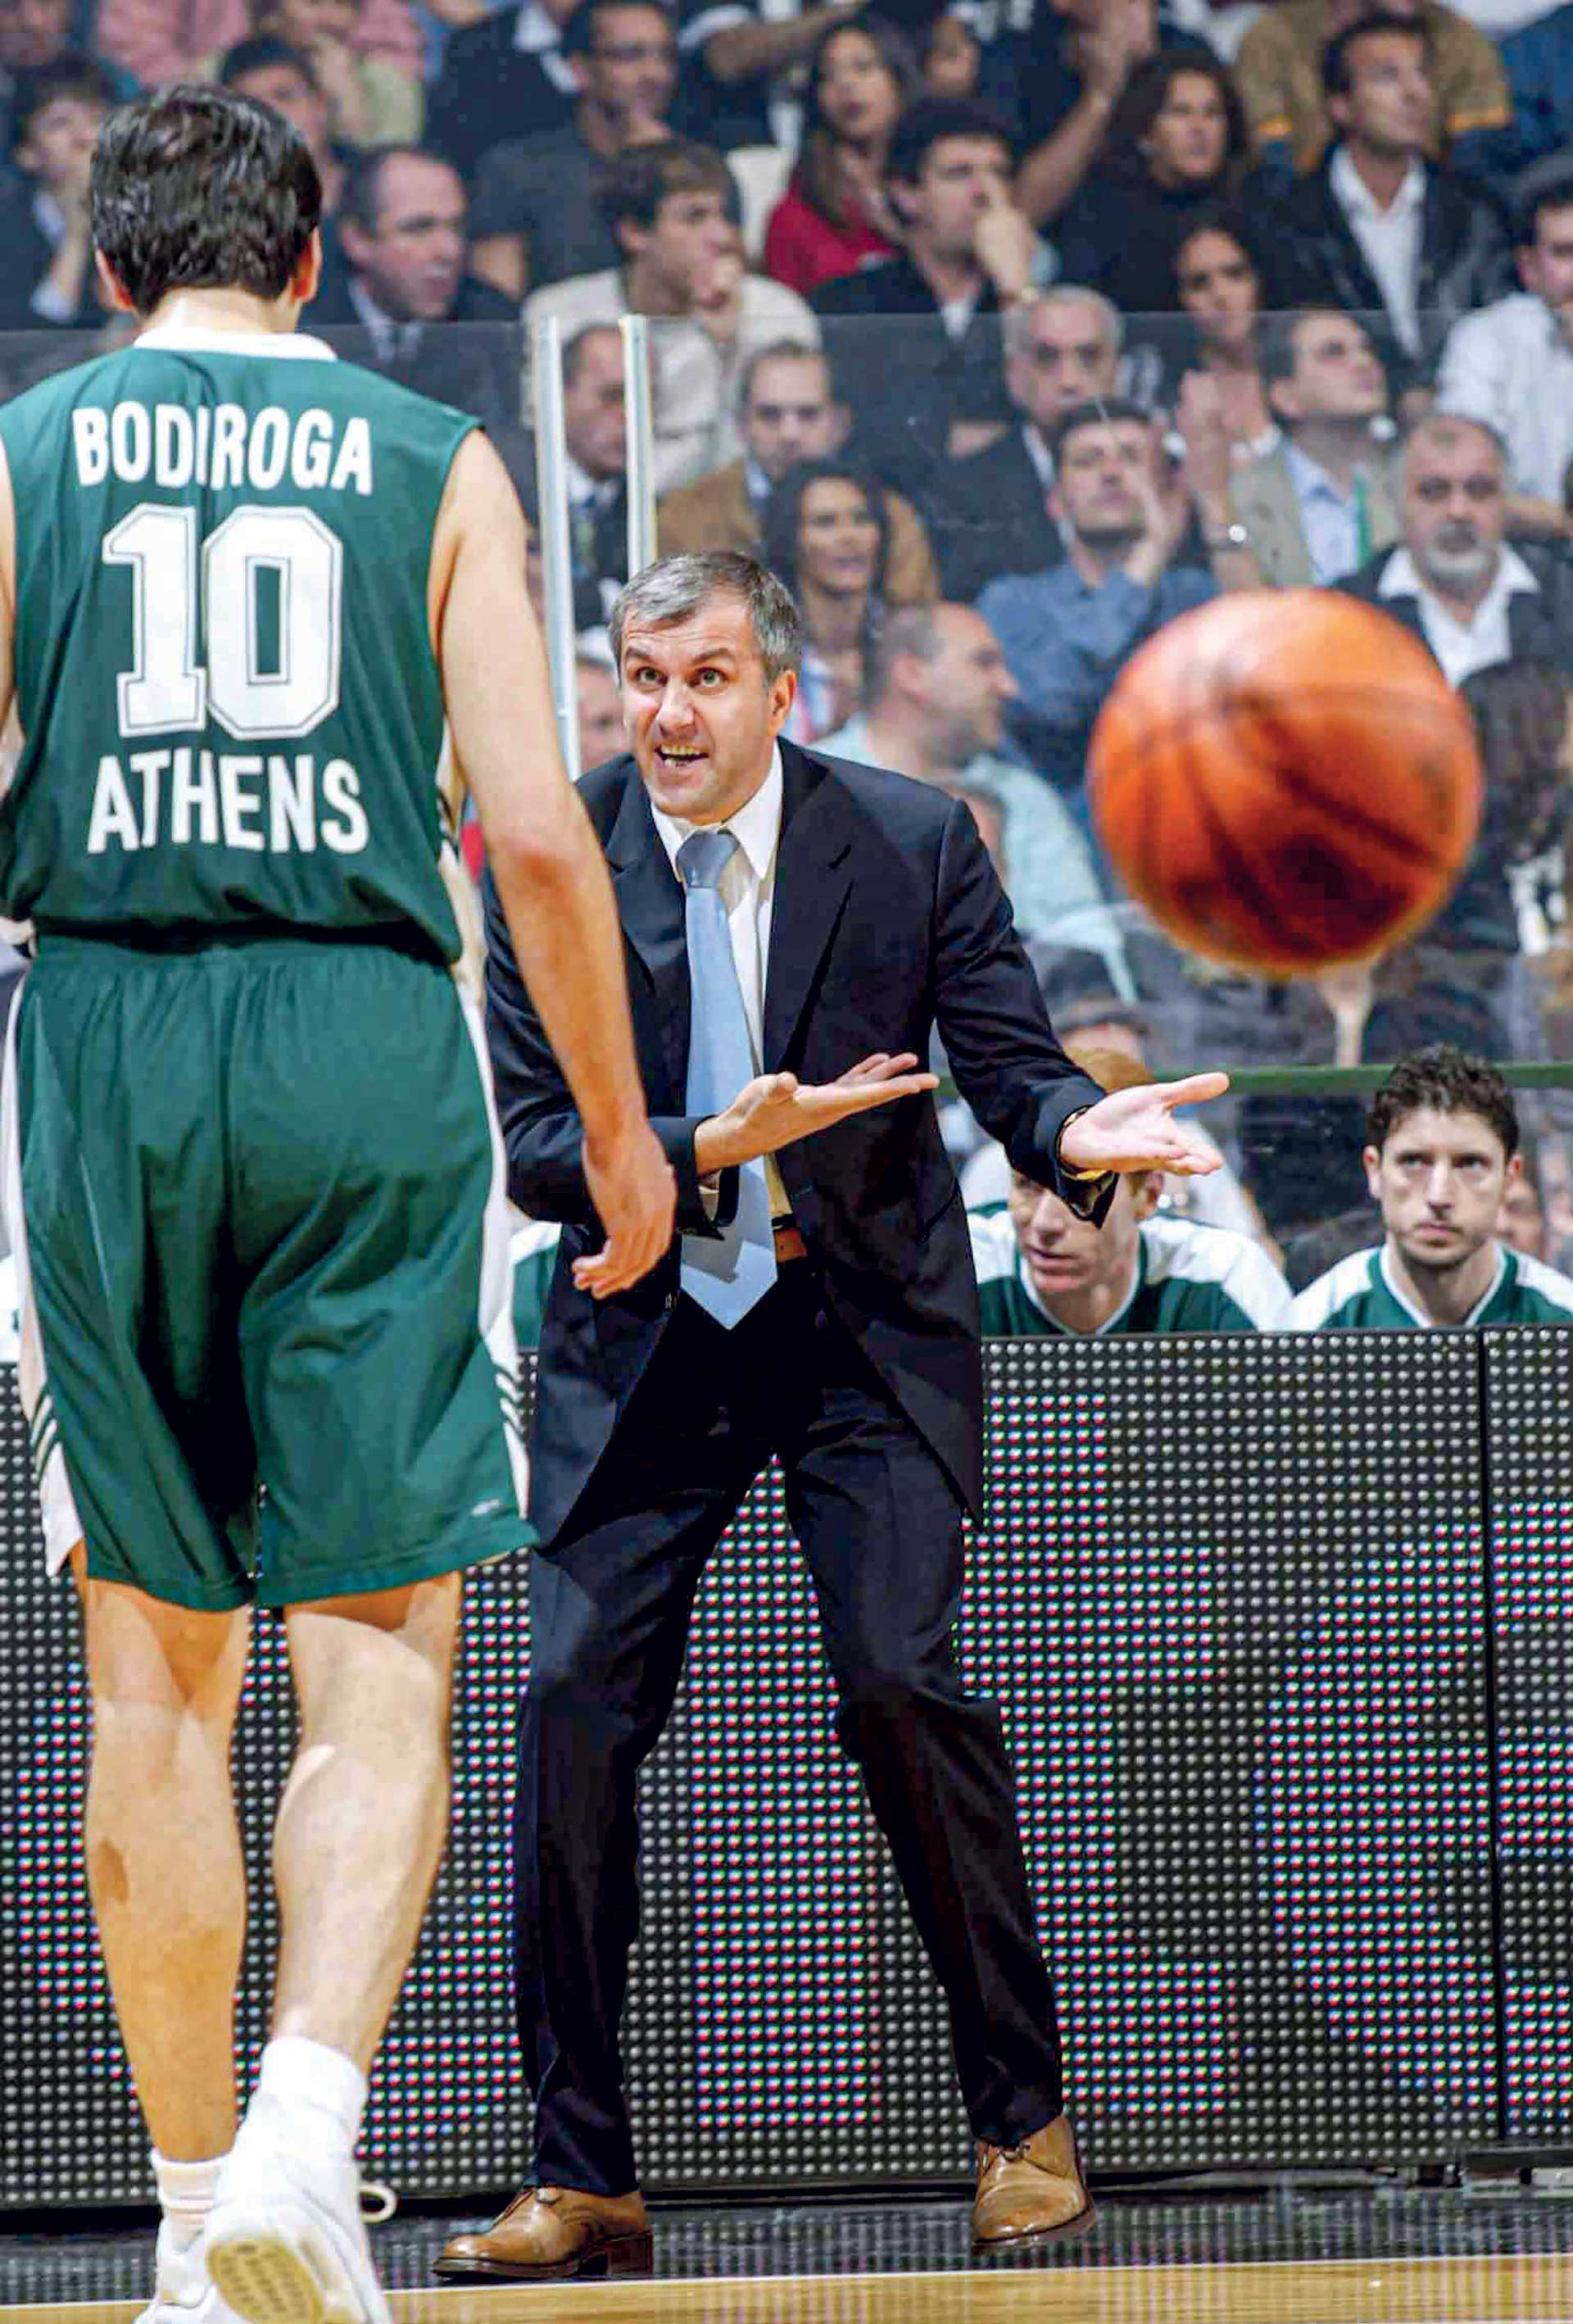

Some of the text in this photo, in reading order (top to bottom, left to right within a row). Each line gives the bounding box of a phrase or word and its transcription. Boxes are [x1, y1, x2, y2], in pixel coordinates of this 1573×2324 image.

[72, 401, 374, 495] BODIROGA
[102, 502, 342, 740] 10
[87, 747, 369, 855] ATHENS
